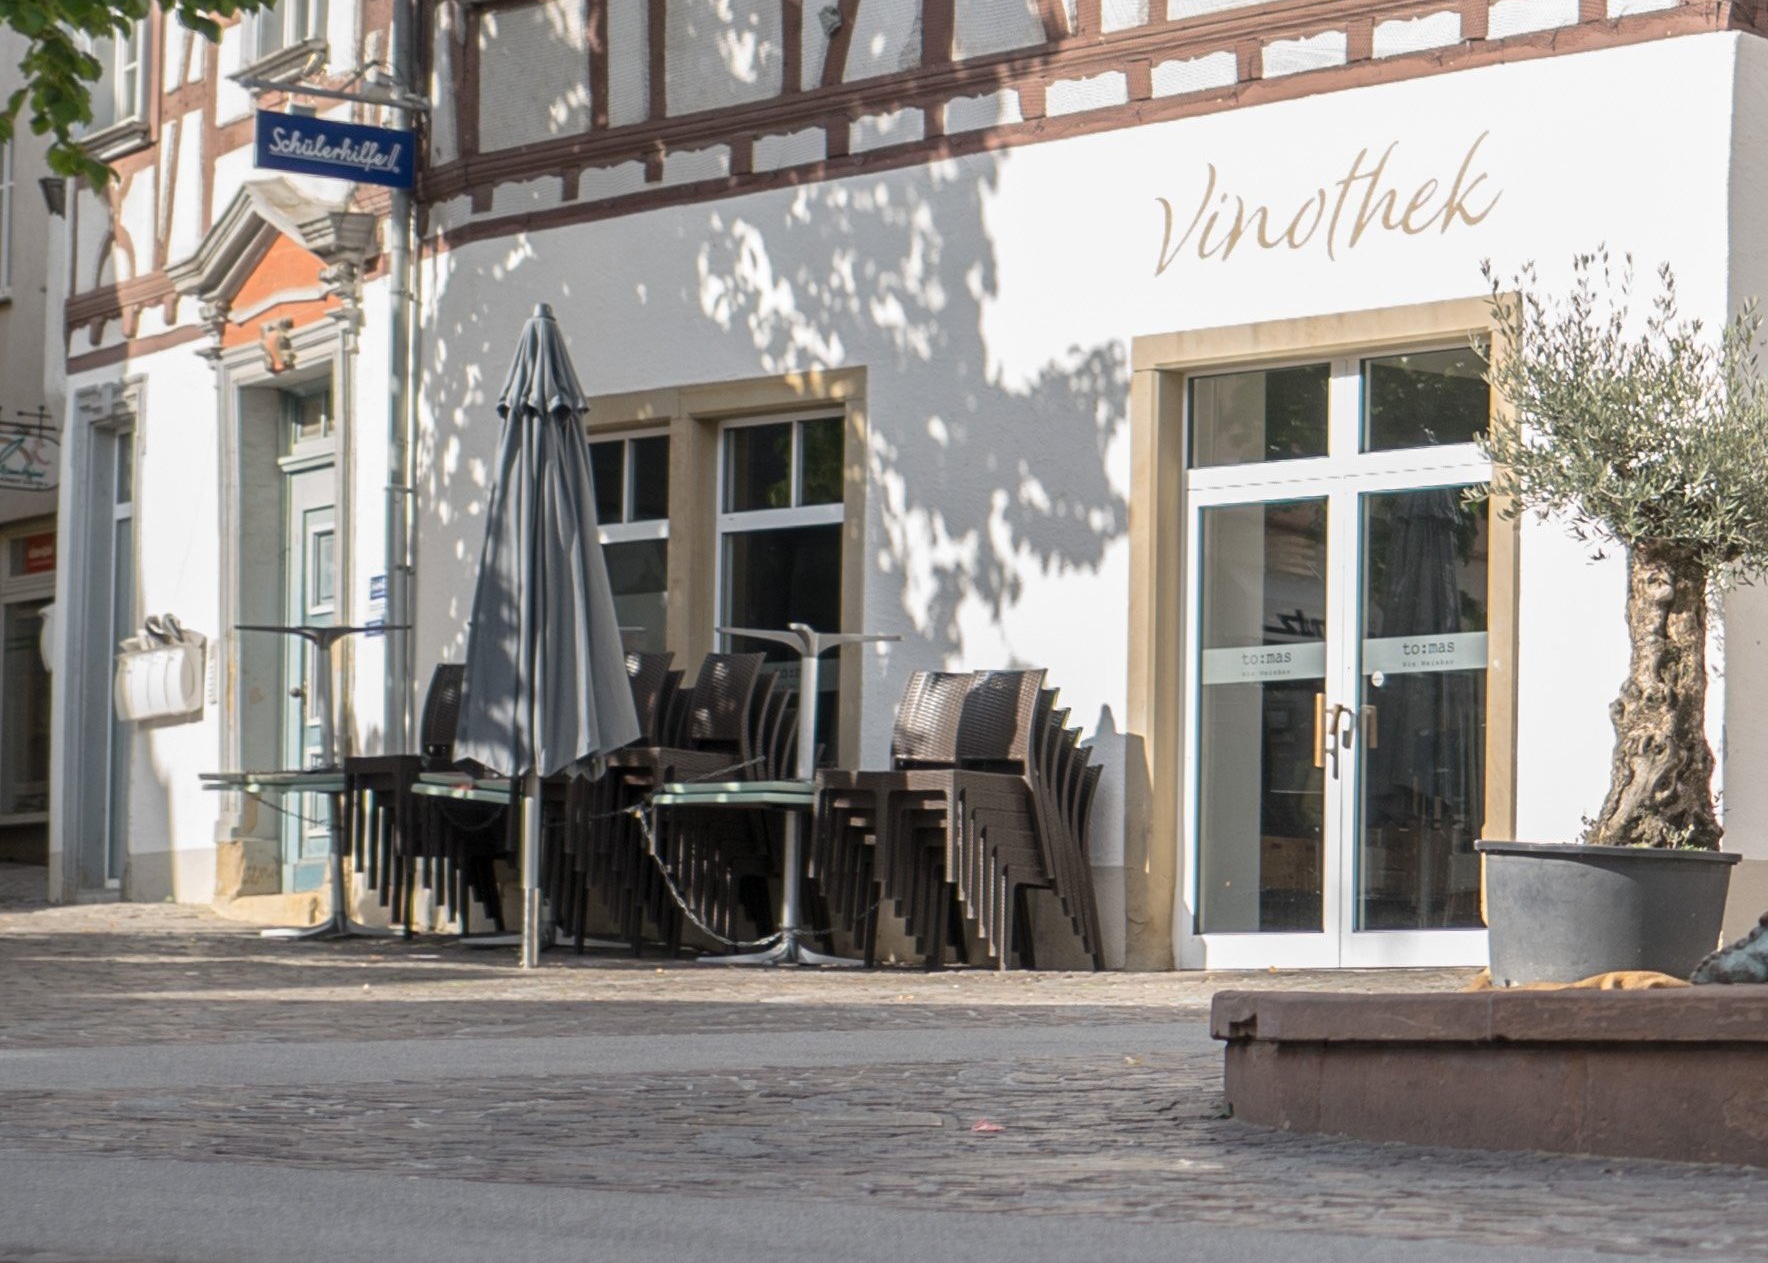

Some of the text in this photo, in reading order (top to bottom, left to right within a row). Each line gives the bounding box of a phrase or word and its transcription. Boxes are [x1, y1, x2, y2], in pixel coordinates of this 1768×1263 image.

[269, 127, 401, 174] Schülerhilfe!
[1155, 130, 1503, 277] Vinothek
[1241, 650, 1292, 665] to:mas
[1403, 640, 1455, 655] to:mas
